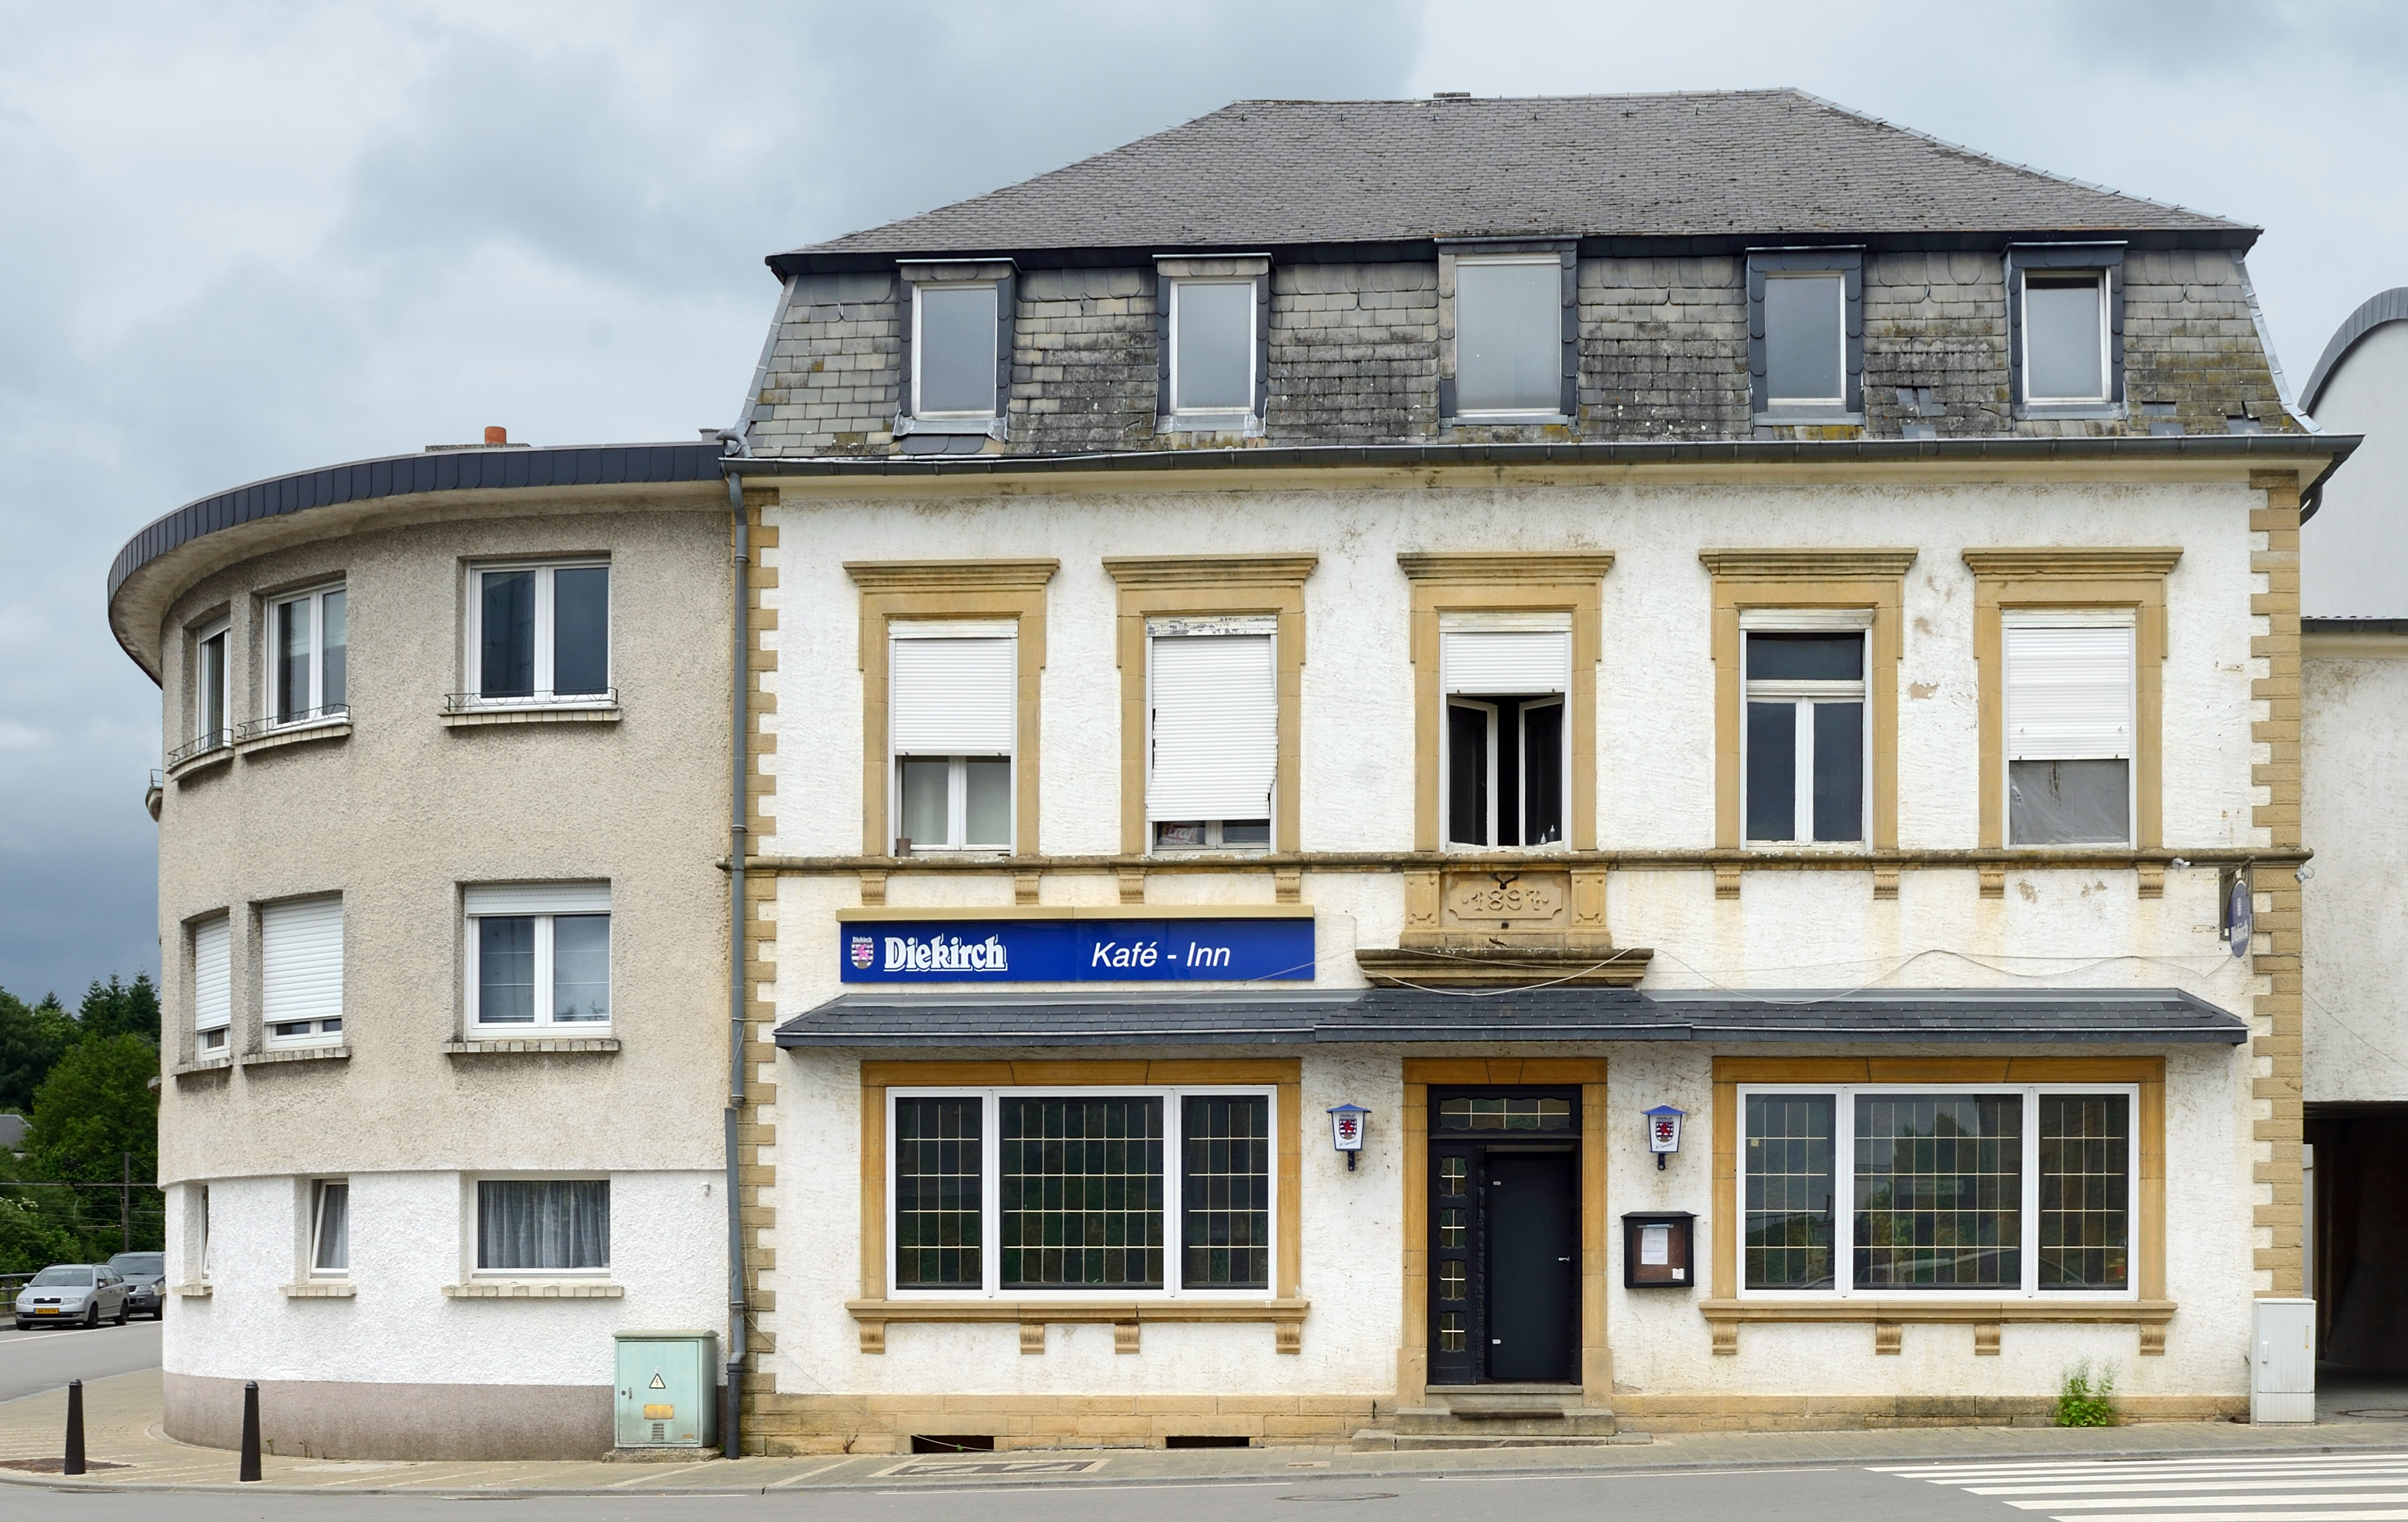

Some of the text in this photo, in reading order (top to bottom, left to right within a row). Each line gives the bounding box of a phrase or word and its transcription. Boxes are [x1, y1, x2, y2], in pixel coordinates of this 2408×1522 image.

[884, 934, 1007, 972] Diekirch
[1092, 941, 1157, 967] Kafé
[1186, 942, 1230, 967] Inn
